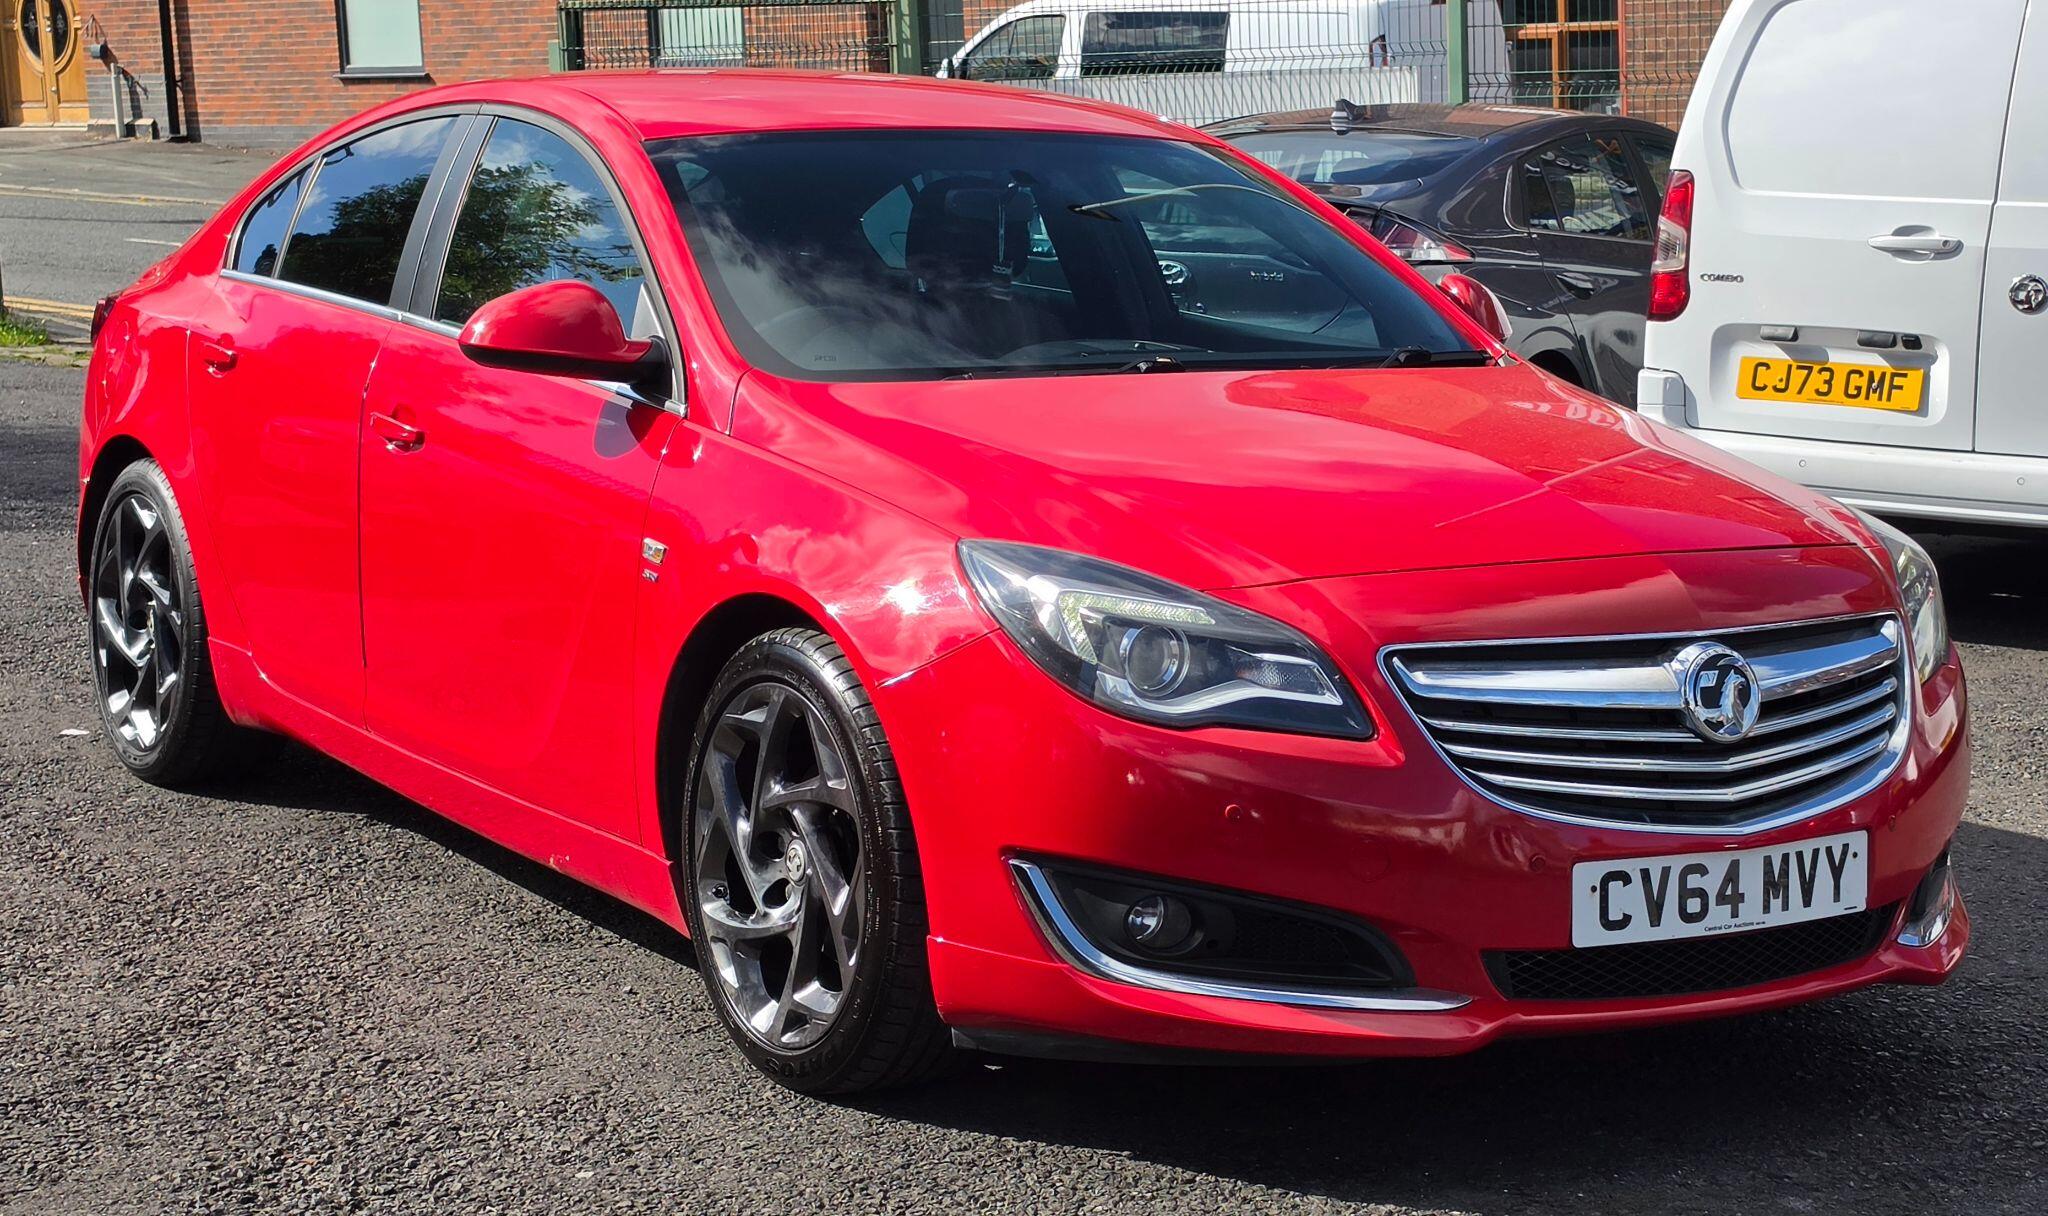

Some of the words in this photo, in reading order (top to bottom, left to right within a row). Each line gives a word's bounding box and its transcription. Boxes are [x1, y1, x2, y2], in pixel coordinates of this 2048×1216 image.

[1700, 273, 1744, 283] COMBO
[1751, 361, 1835, 397] CJ73
[1844, 369, 1909, 402] GMF
[1598, 858, 1745, 931] CV64
[1762, 843, 1850, 915] MVY
